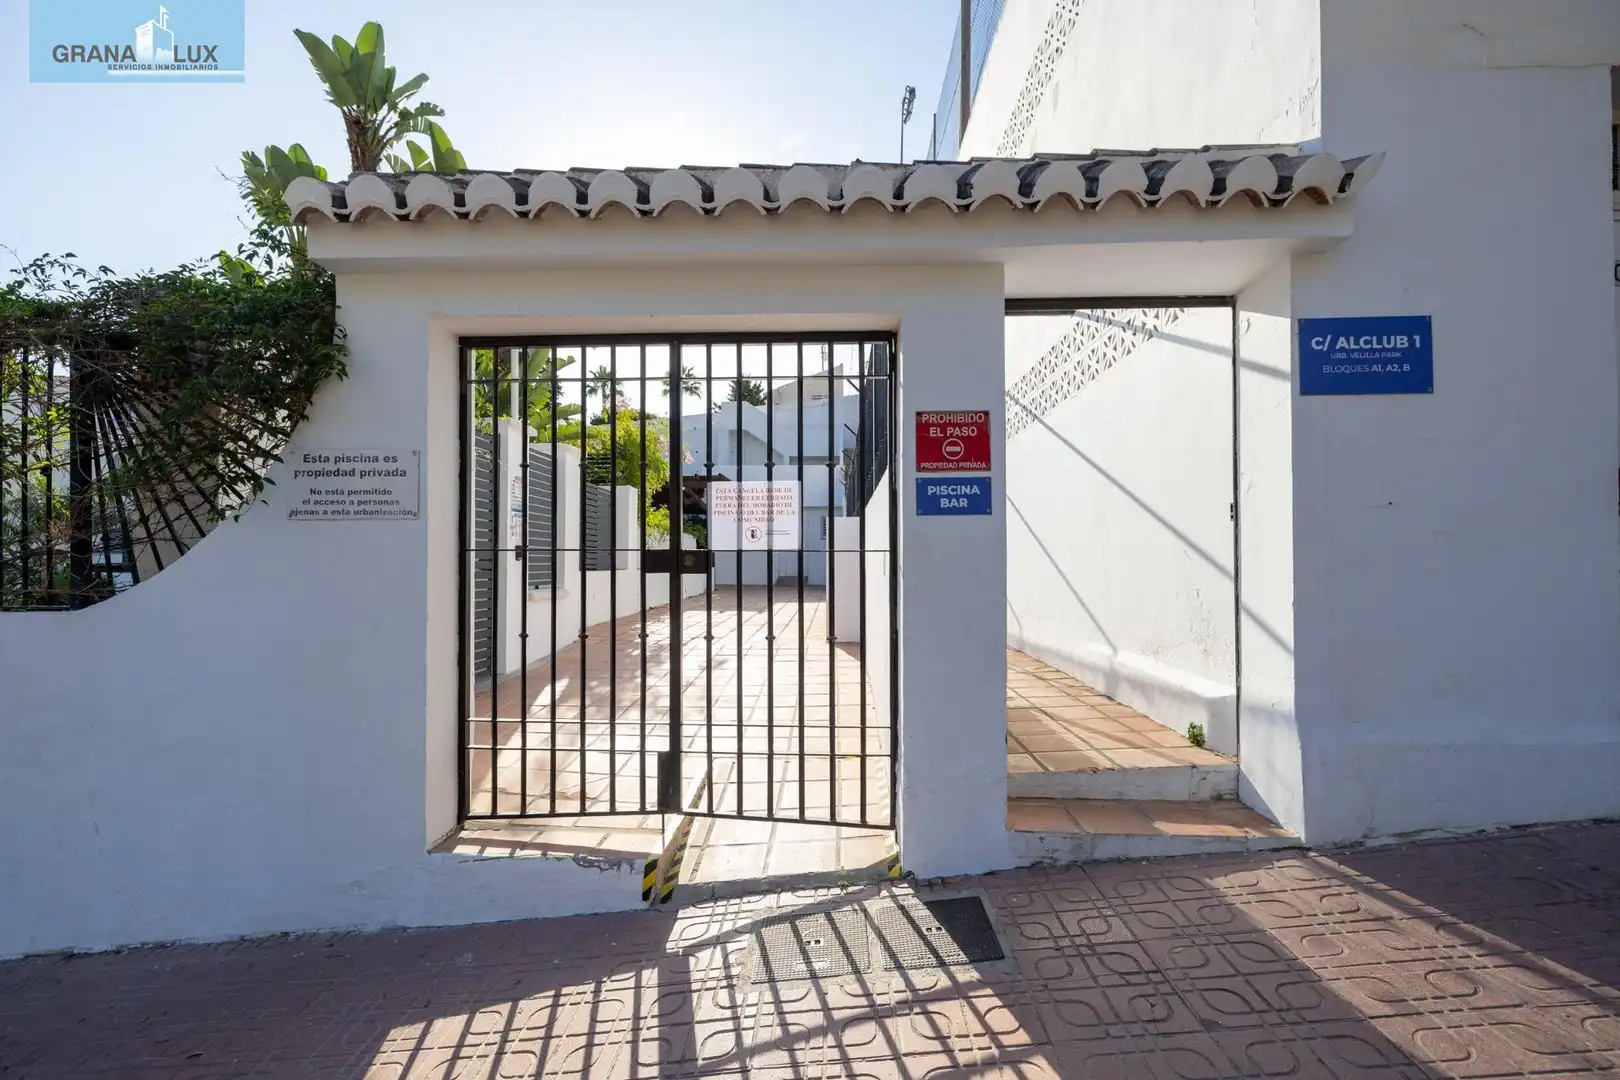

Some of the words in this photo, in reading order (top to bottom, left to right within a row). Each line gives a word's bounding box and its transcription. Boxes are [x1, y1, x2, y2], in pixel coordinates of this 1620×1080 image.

[1311, 335, 1332, 351] C/
[1335, 335, 1409, 349] ALCLUB
[1412, 335, 1421, 348] 1
[1323, 365, 1369, 373] BLOQUES
[1386, 364, 1401, 373] A2,
[922, 412, 985, 423] PROHIBIDO
[930, 427, 944, 437] EL
[947, 426, 978, 437] PASO
[303, 454, 330, 463] Esta
[334, 453, 379, 465] piscina
[383, 455, 398, 463] es
[294, 467, 356, 479] propiedad
[360, 467, 407, 479] privada
[325, 487, 345, 495] está
[348, 488, 393, 497] permitido
[927, 485, 981, 496] PISCINA
[302, 498, 311, 506] el
[357, 499, 400, 507] personas
[940, 498, 968, 508] BAR
[331, 508, 350, 516] esta
